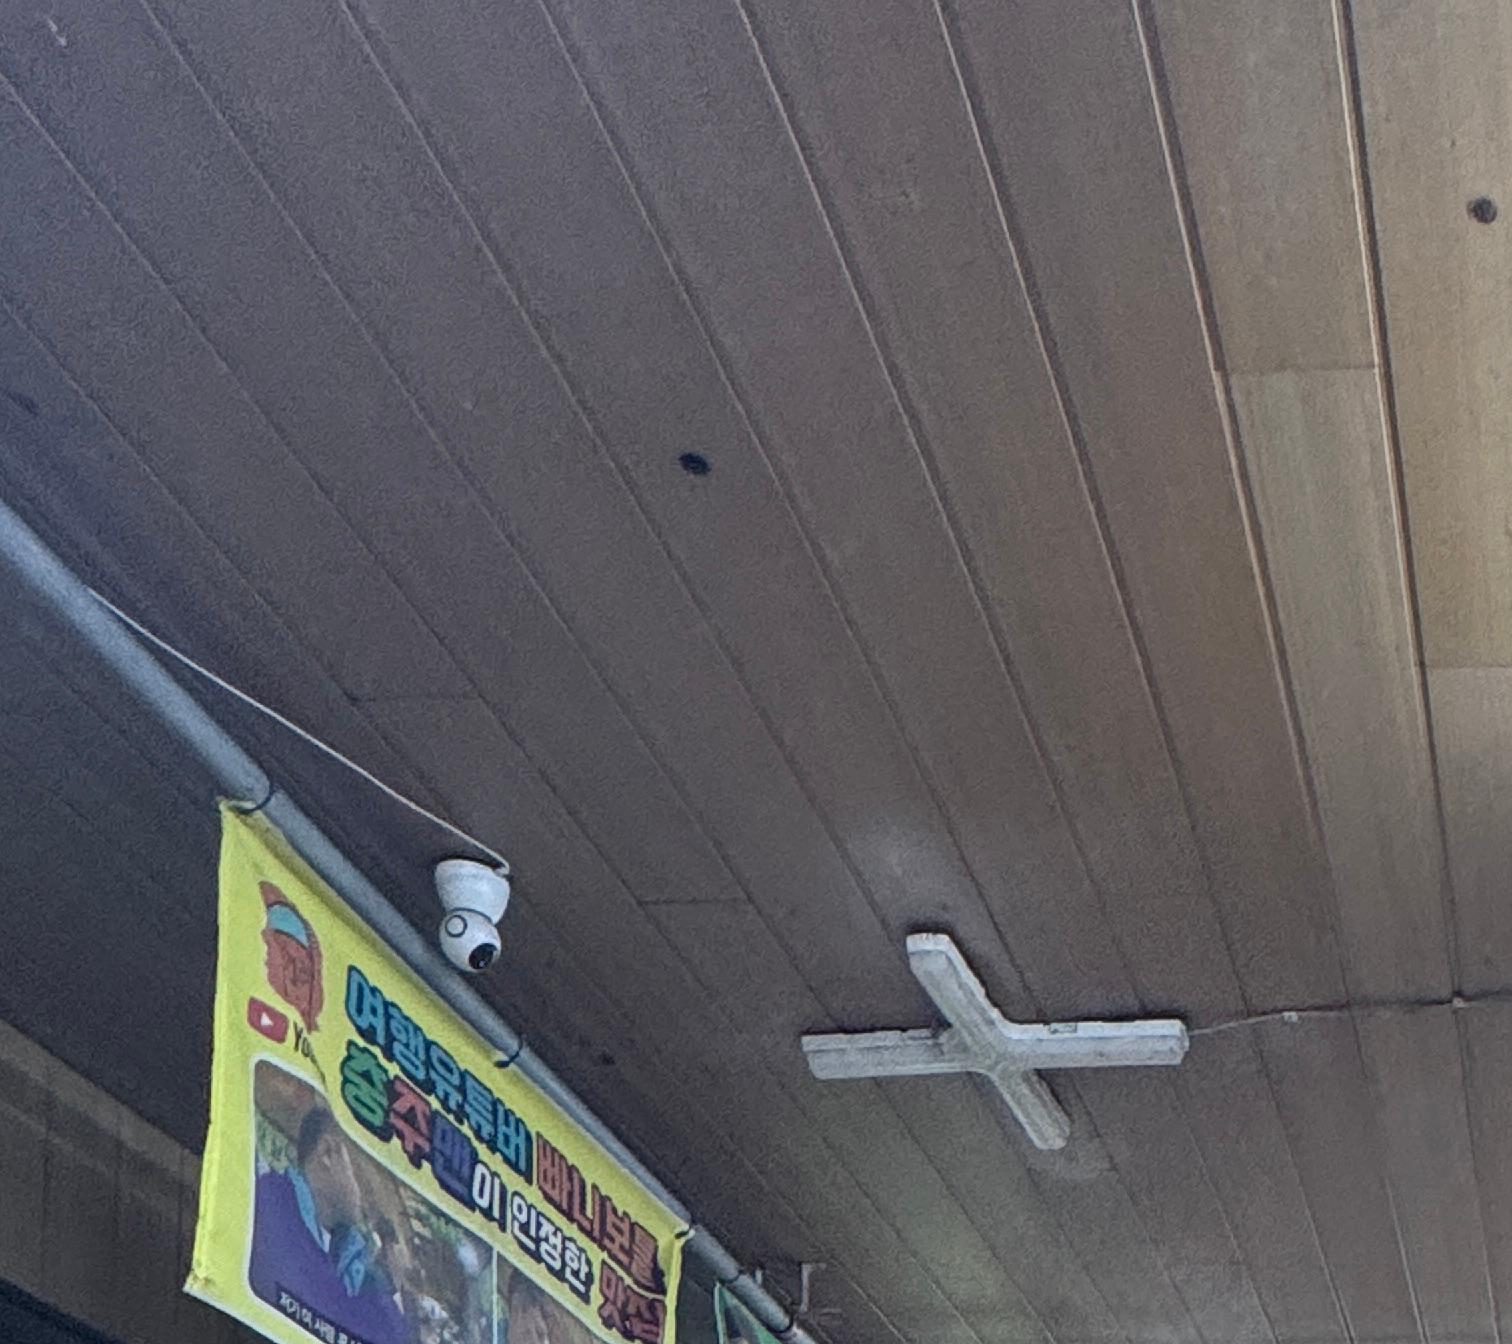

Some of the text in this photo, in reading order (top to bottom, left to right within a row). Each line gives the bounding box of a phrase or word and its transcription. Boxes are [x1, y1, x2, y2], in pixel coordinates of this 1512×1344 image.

[340, 1039, 508, 1234] 충주맨이
[510, 1190, 592, 1308] 인정한
[345, 963, 535, 1175] 여행유튜버
